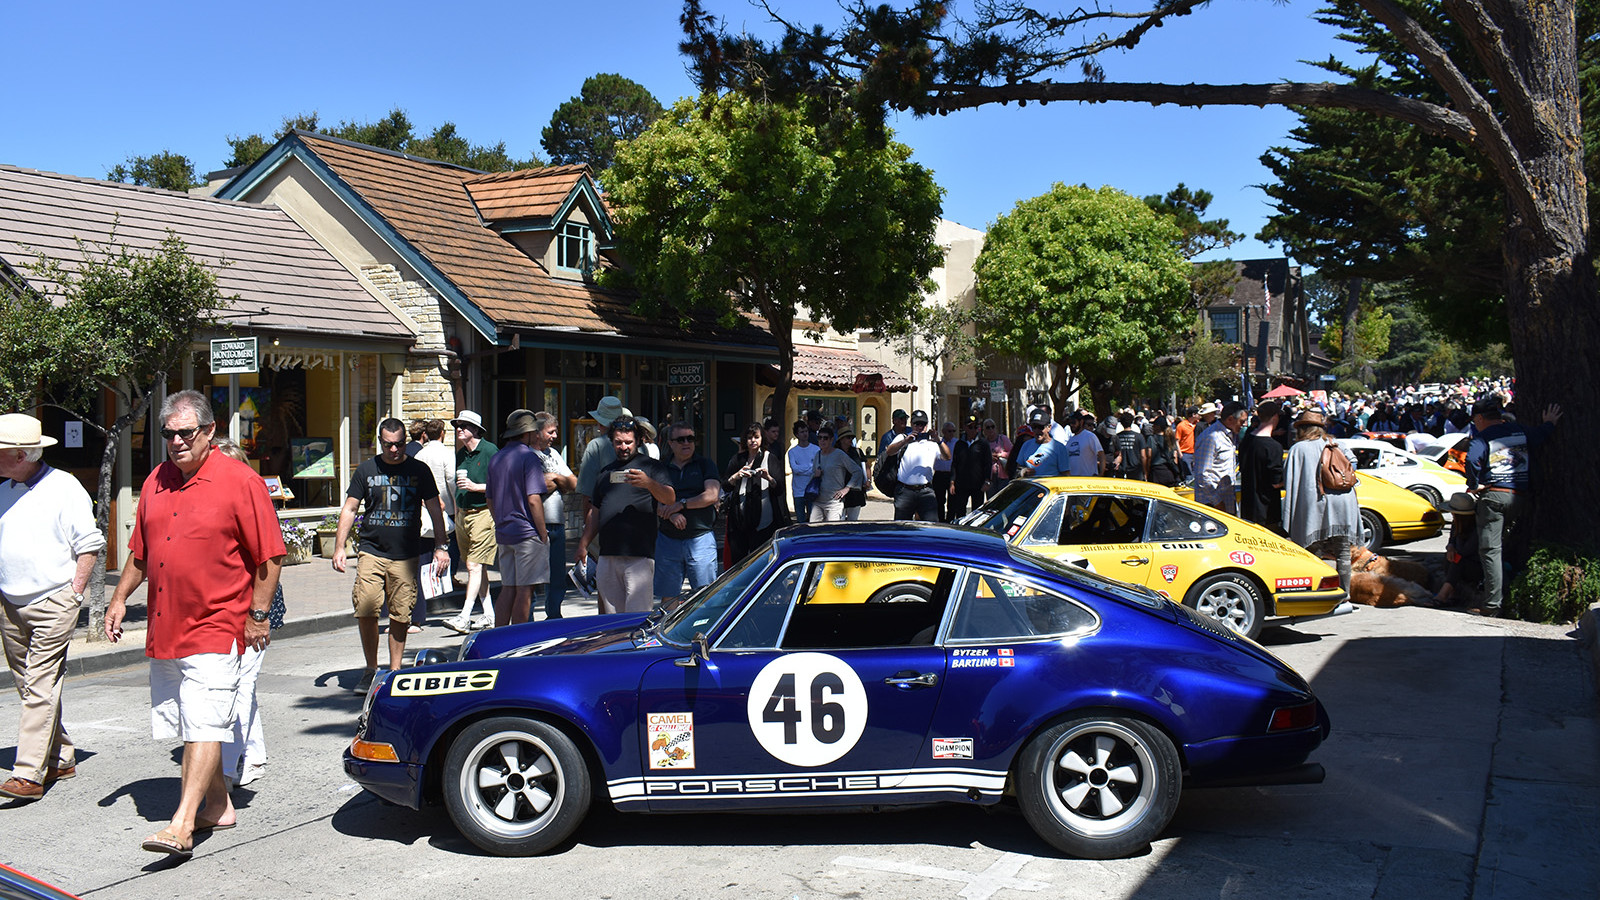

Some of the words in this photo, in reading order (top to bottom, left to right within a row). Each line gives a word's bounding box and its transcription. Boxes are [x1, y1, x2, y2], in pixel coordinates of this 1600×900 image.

[221, 342, 245, 350] EDWARD
[213, 349, 253, 359] MONTGOMERY
[670, 365, 701, 374] GALLERY
[679, 374, 702, 383] 1000
[367, 475, 417, 487] SURFING
[1234, 533, 1258, 546] Toad
[1258, 537, 1279, 550] Hall
[1080, 544, 1115, 552] Michael
[1231, 551, 1253, 564] STP
[1277, 578, 1310, 587] FERODO
[951, 658, 997, 668] BARTLING
[397, 676, 468, 691] CIBIE
[762, 671, 845, 744] 46
[650, 715, 690, 724] CAMEL
[646, 776, 877, 794] PORSCHE
